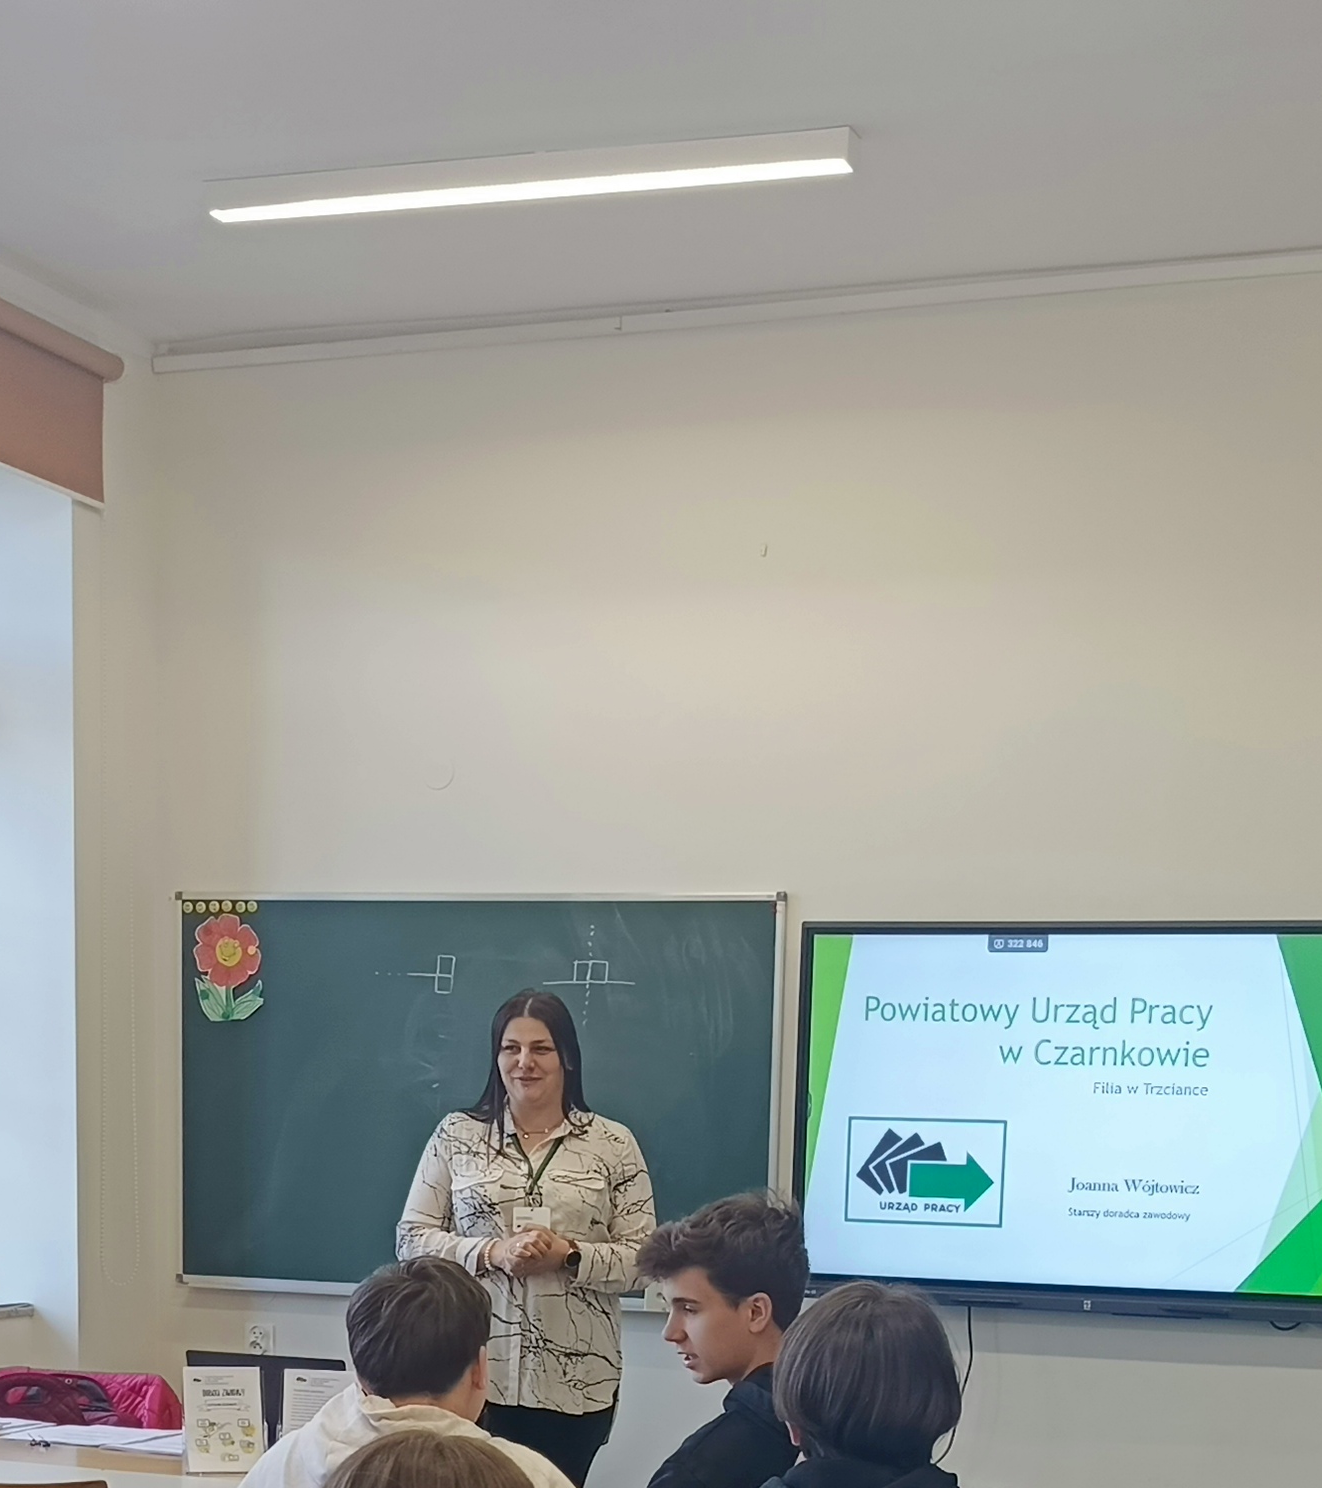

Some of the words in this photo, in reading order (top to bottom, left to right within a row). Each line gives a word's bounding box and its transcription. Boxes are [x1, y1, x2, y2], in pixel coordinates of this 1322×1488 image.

[1007, 939, 1024, 948] 322
[864, 996, 1019, 1029] Powiatowy
[1031, 997, 1117, 1029] Urząd
[1130, 997, 1212, 1031] Pracy
[999, 1045, 1023, 1064] w
[1034, 1039, 1210, 1067] Czarnkowie
[1092, 1082, 1122, 1095] Filia
[1127, 1084, 1139, 1095] w
[1143, 1082, 1209, 1096] Trzciance
[1067, 1177, 1119, 1193] Joanna
[1123, 1178, 1200, 1196] Wójtowicz
[879, 1201, 918, 1213] URZĄD
[923, 1203, 961, 1213] PRACY
[1068, 1207, 1101, 1219] Starszy
[1103, 1209, 1140, 1219] doradca
[1142, 1211, 1191, 1222] zawodowy
